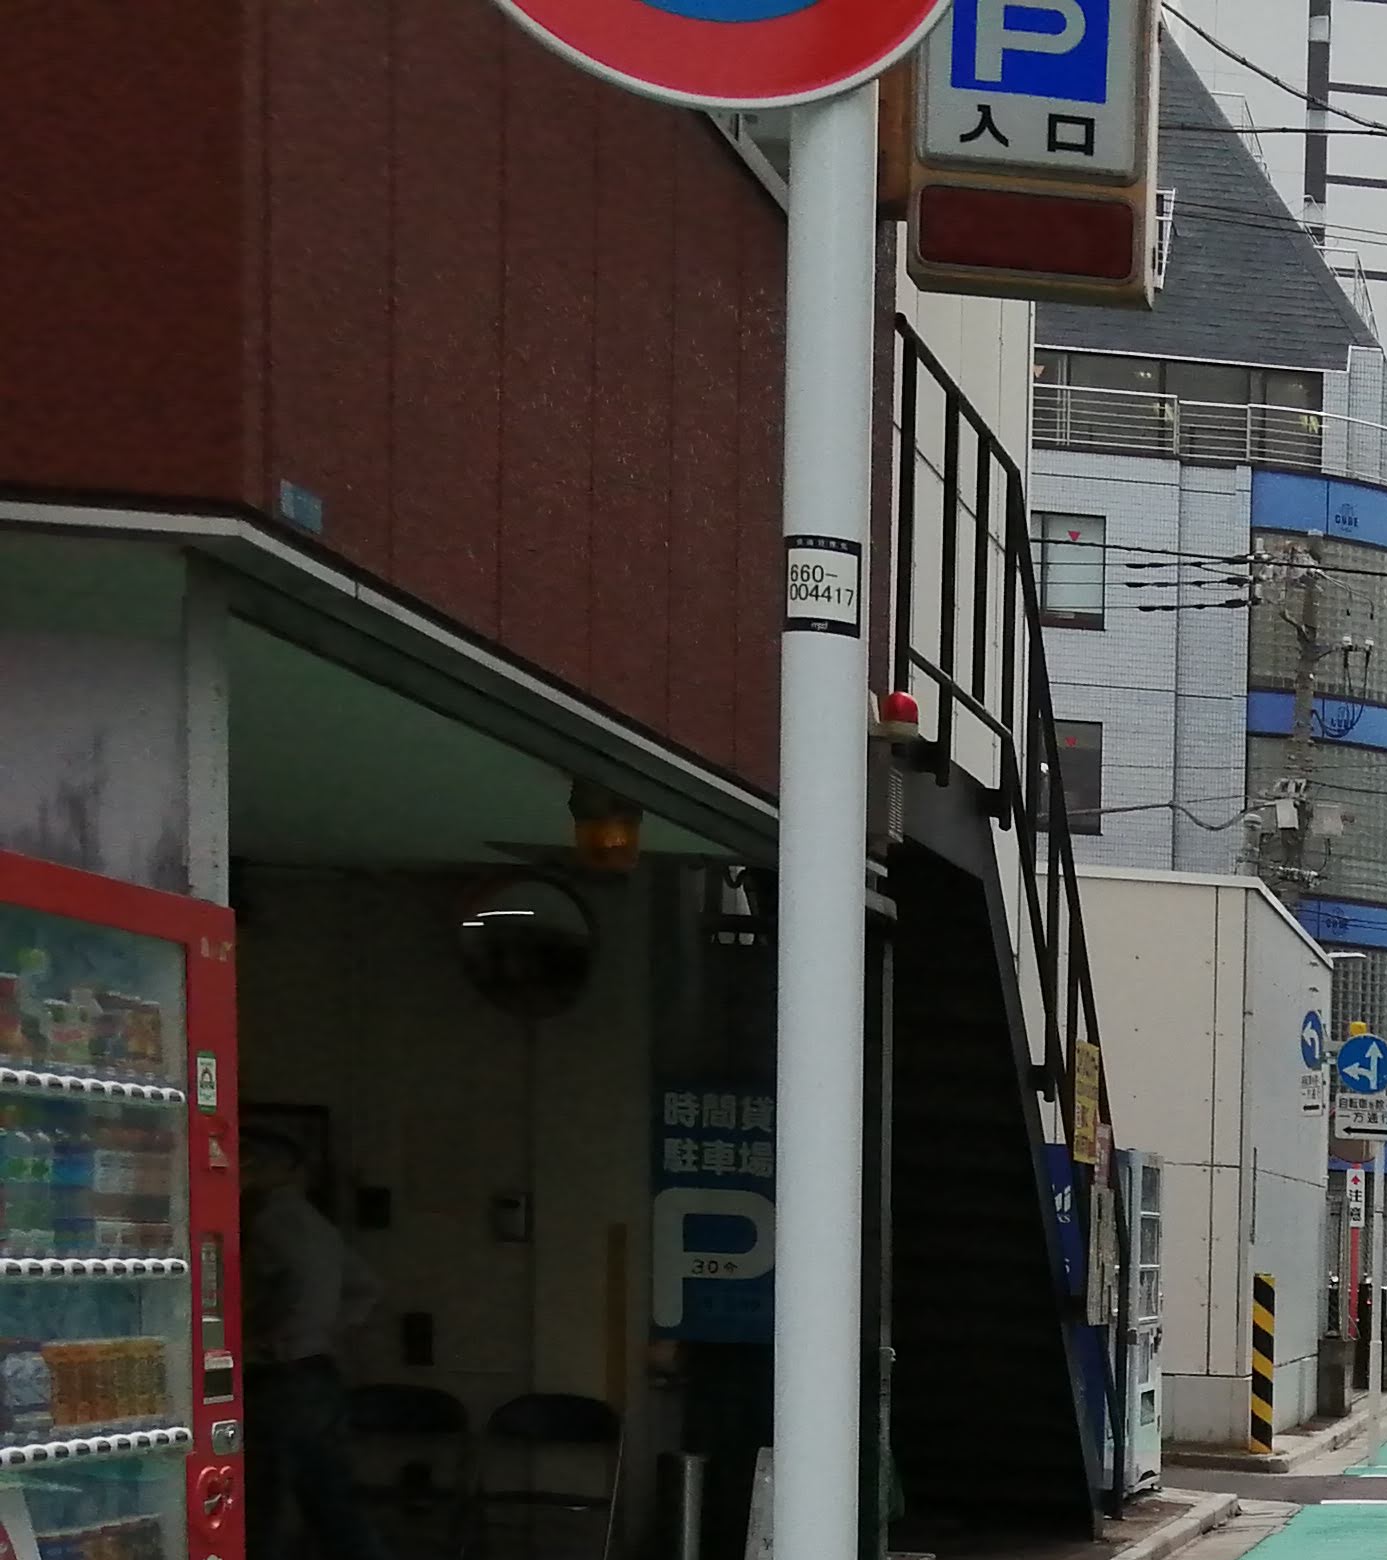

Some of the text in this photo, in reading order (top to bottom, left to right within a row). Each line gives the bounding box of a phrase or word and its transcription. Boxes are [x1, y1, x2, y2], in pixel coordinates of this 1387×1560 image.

[975, 0, 1087, 83] P
[959, 103, 1096, 157] 入口
[790, 564, 838, 583] 660-
[789, 583, 854, 607] 004417
[663, 1091, 775, 1132] 時間貸
[663, 1138, 775, 1178] 駐車場
[1348, 1189, 1363, 1222] 注意
[652, 1186, 776, 1328] P
